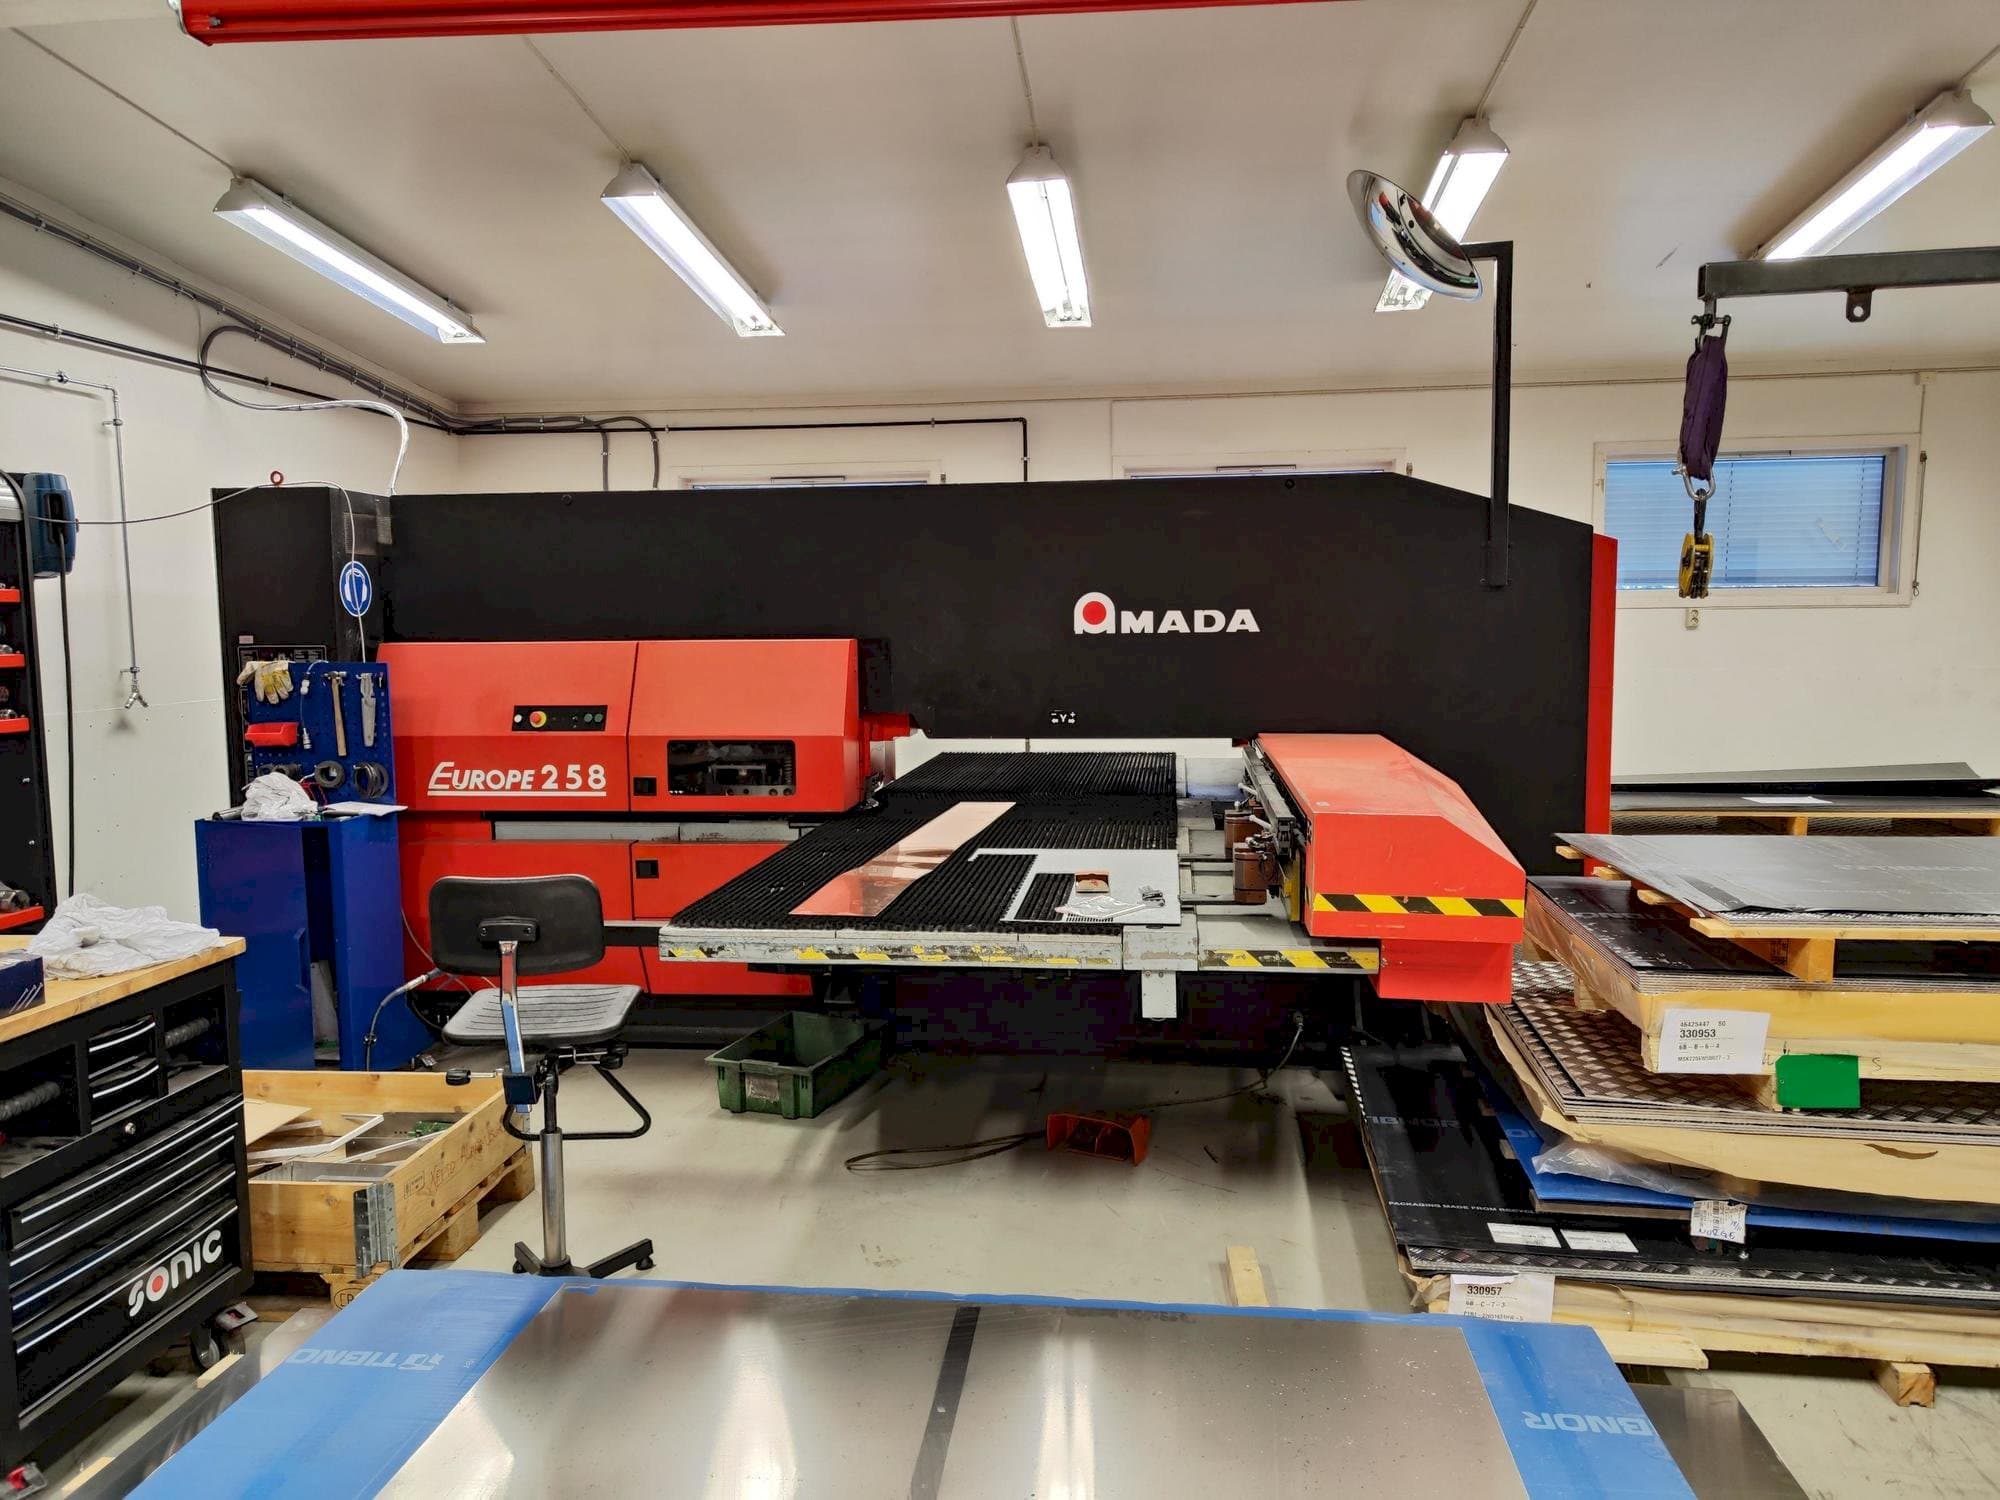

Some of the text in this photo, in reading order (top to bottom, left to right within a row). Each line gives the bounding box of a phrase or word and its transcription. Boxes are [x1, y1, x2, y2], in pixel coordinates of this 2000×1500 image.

[1074, 592, 1261, 635] AMADA
[1680, 1028, 1717, 1039] 330953
[1388, 1200, 1441, 1208] PACKAGING
[1466, 1285, 1502, 1296] 330957
